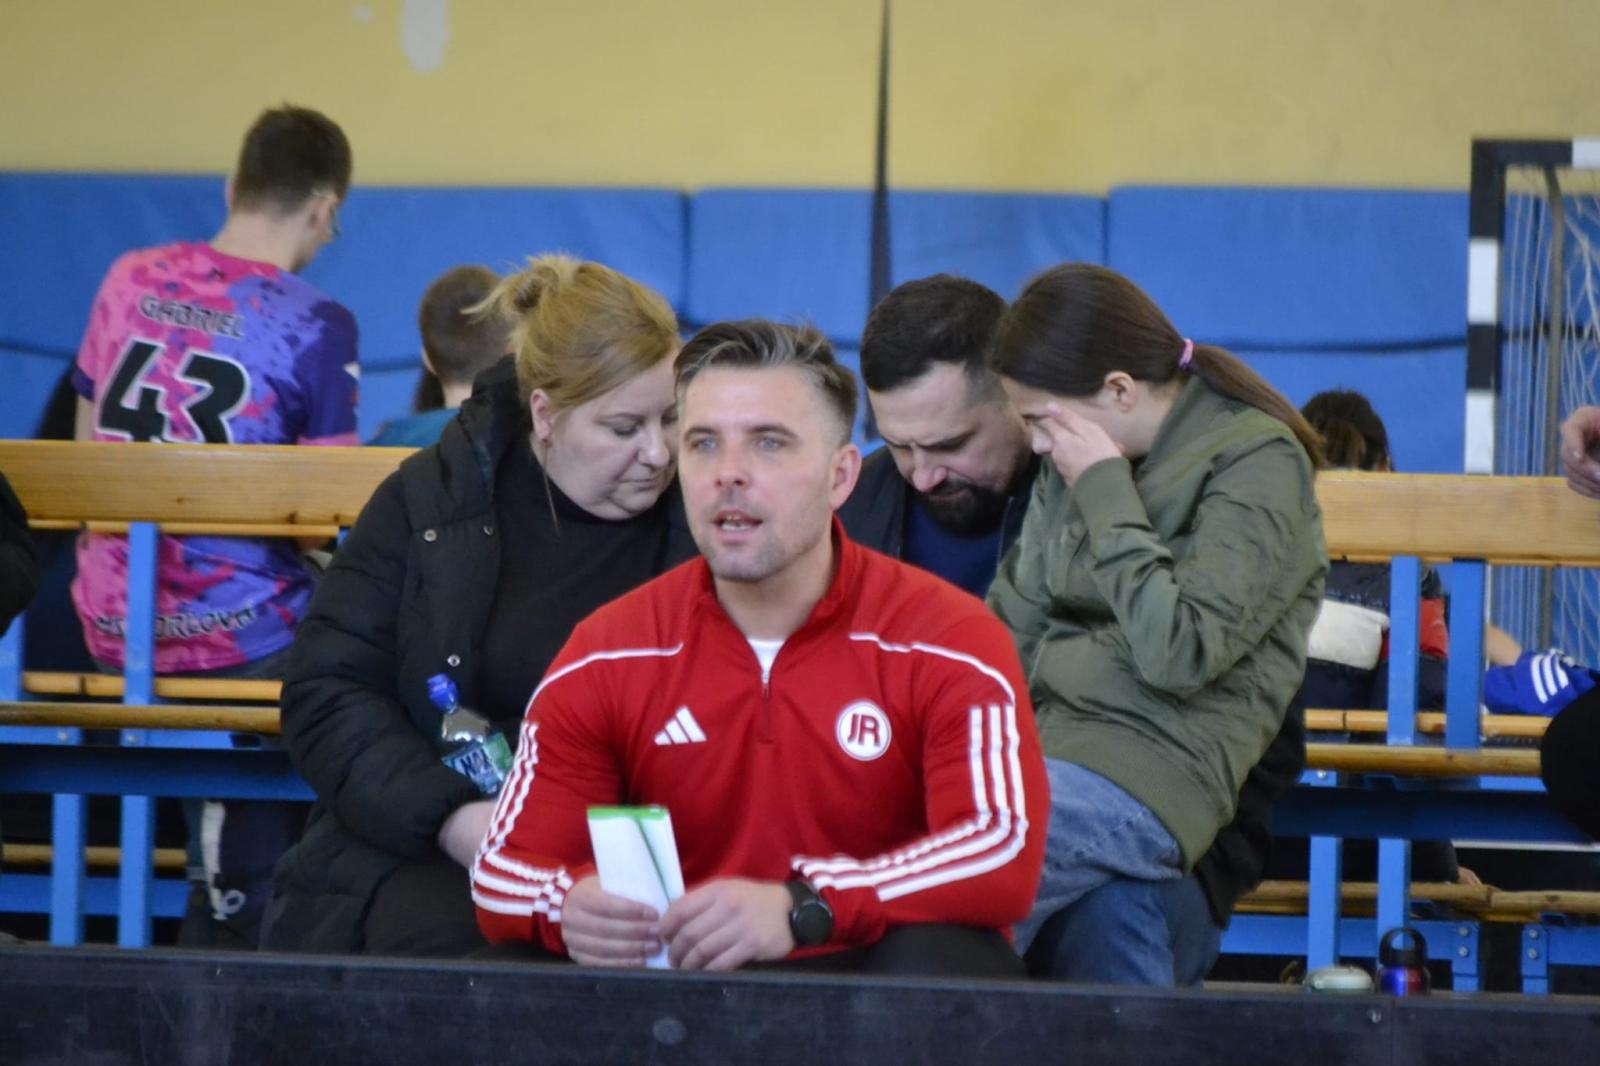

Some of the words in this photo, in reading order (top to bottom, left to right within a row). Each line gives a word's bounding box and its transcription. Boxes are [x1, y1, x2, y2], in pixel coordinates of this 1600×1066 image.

[140, 296, 243, 338] GABRIEL
[97, 337, 250, 443] 43
[847, 713, 881, 747] JR
